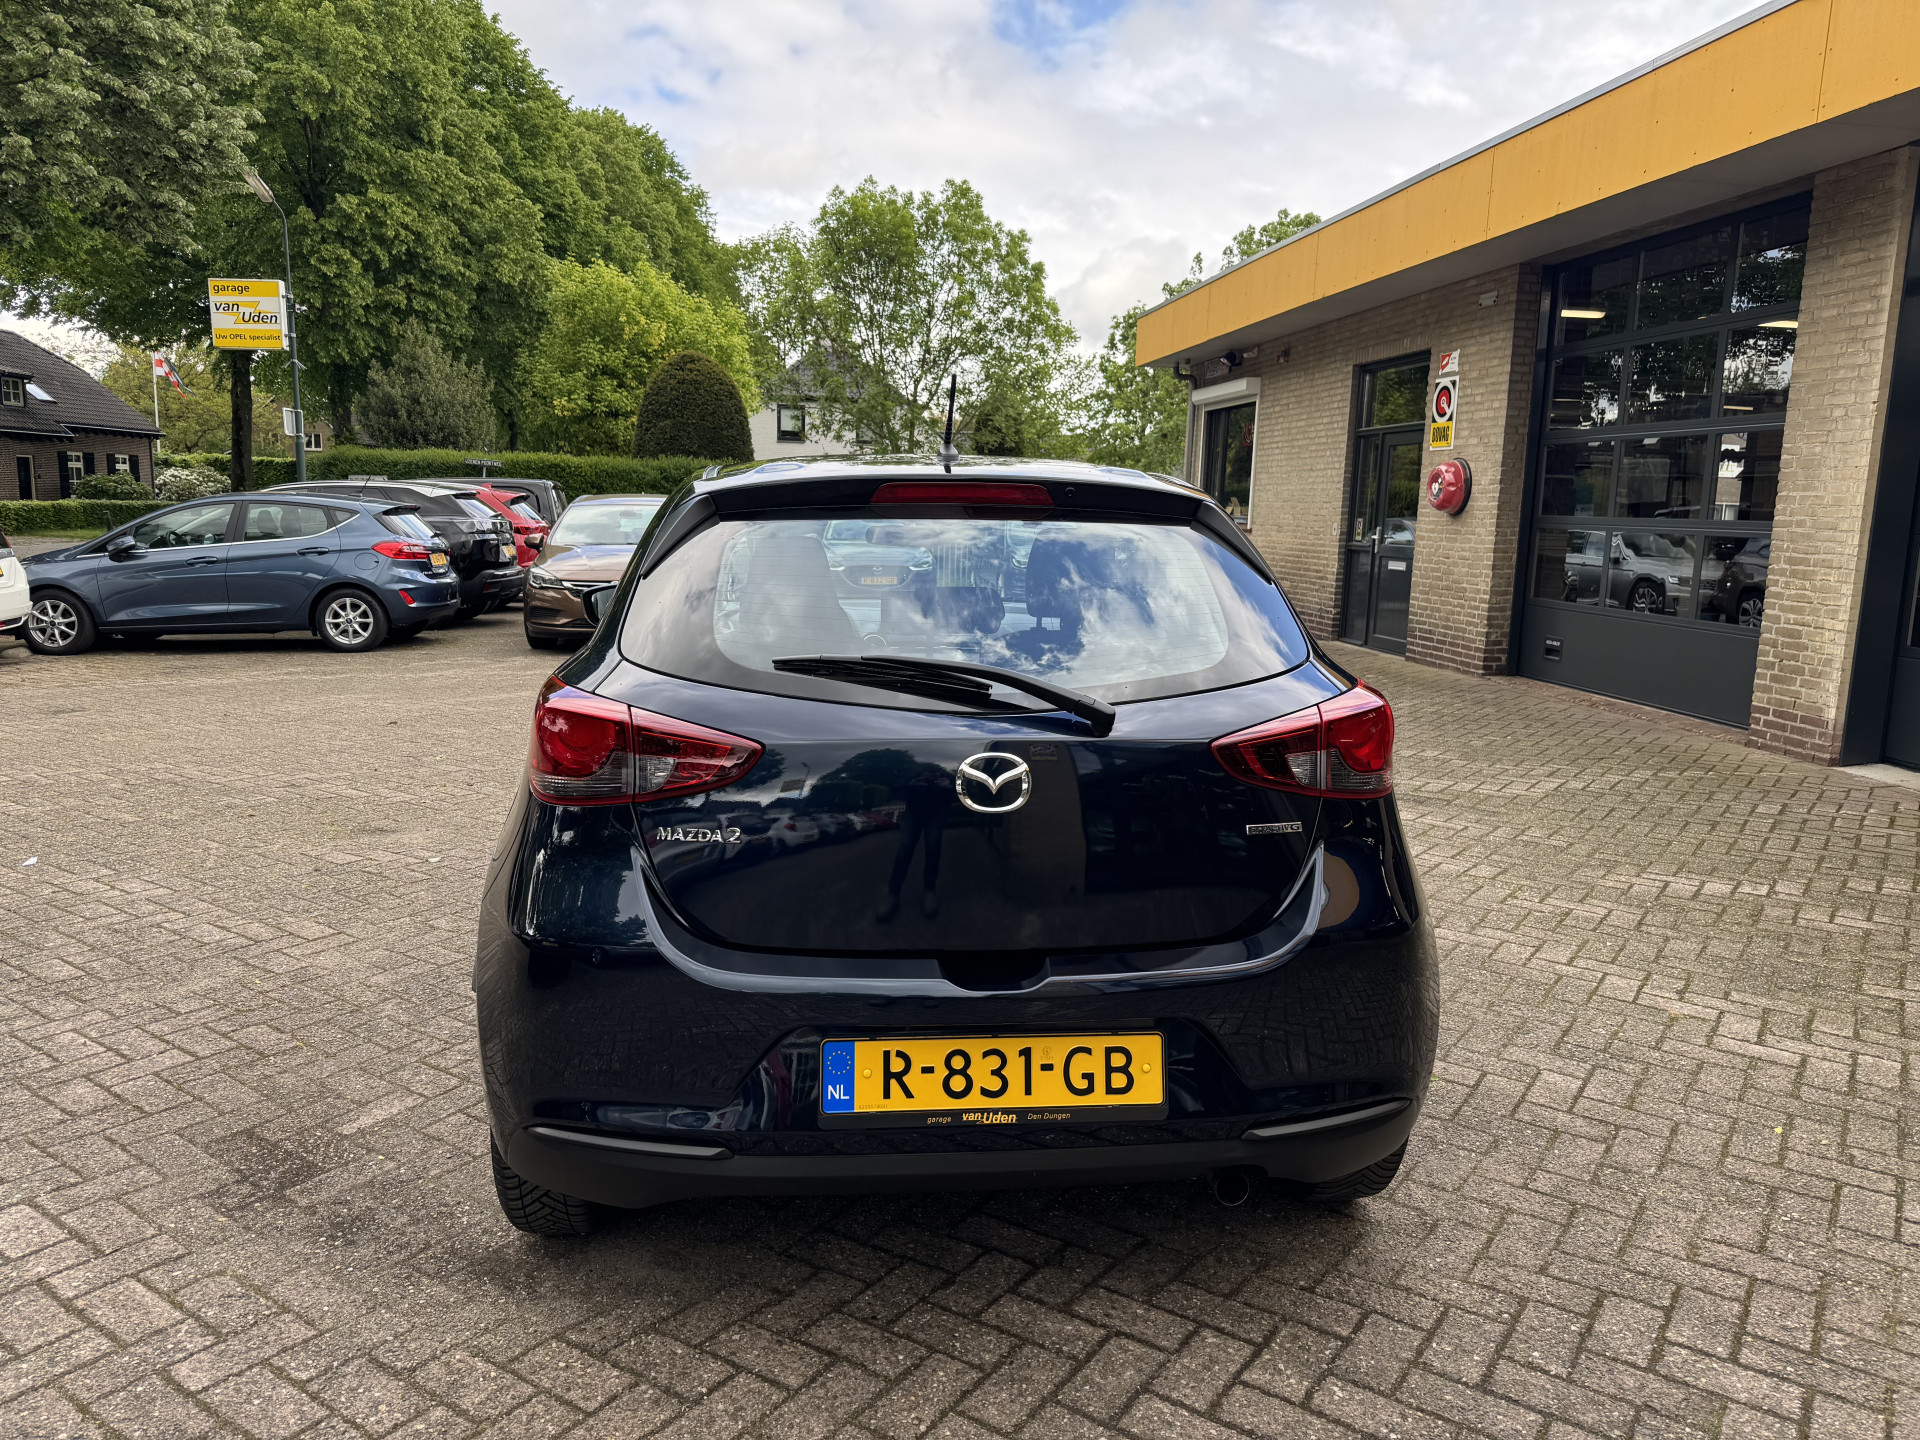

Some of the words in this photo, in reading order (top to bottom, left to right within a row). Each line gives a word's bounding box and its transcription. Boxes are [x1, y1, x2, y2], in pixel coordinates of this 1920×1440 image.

[213, 284, 250, 294] garage
[214, 302, 240, 312] van
[241, 312, 278, 324] Uden
[249, 334, 281, 342] specialist
[1431, 425, 1450, 443] BOVAG
[827, 1084, 850, 1100] NL
[882, 1045, 1135, 1100] R-831-GB
[927, 1116, 951, 1124] garage
[962, 1112, 982, 1121] van
[982, 1111, 1017, 1124] Uden
[1044, 1112, 1071, 1121] Dungen
